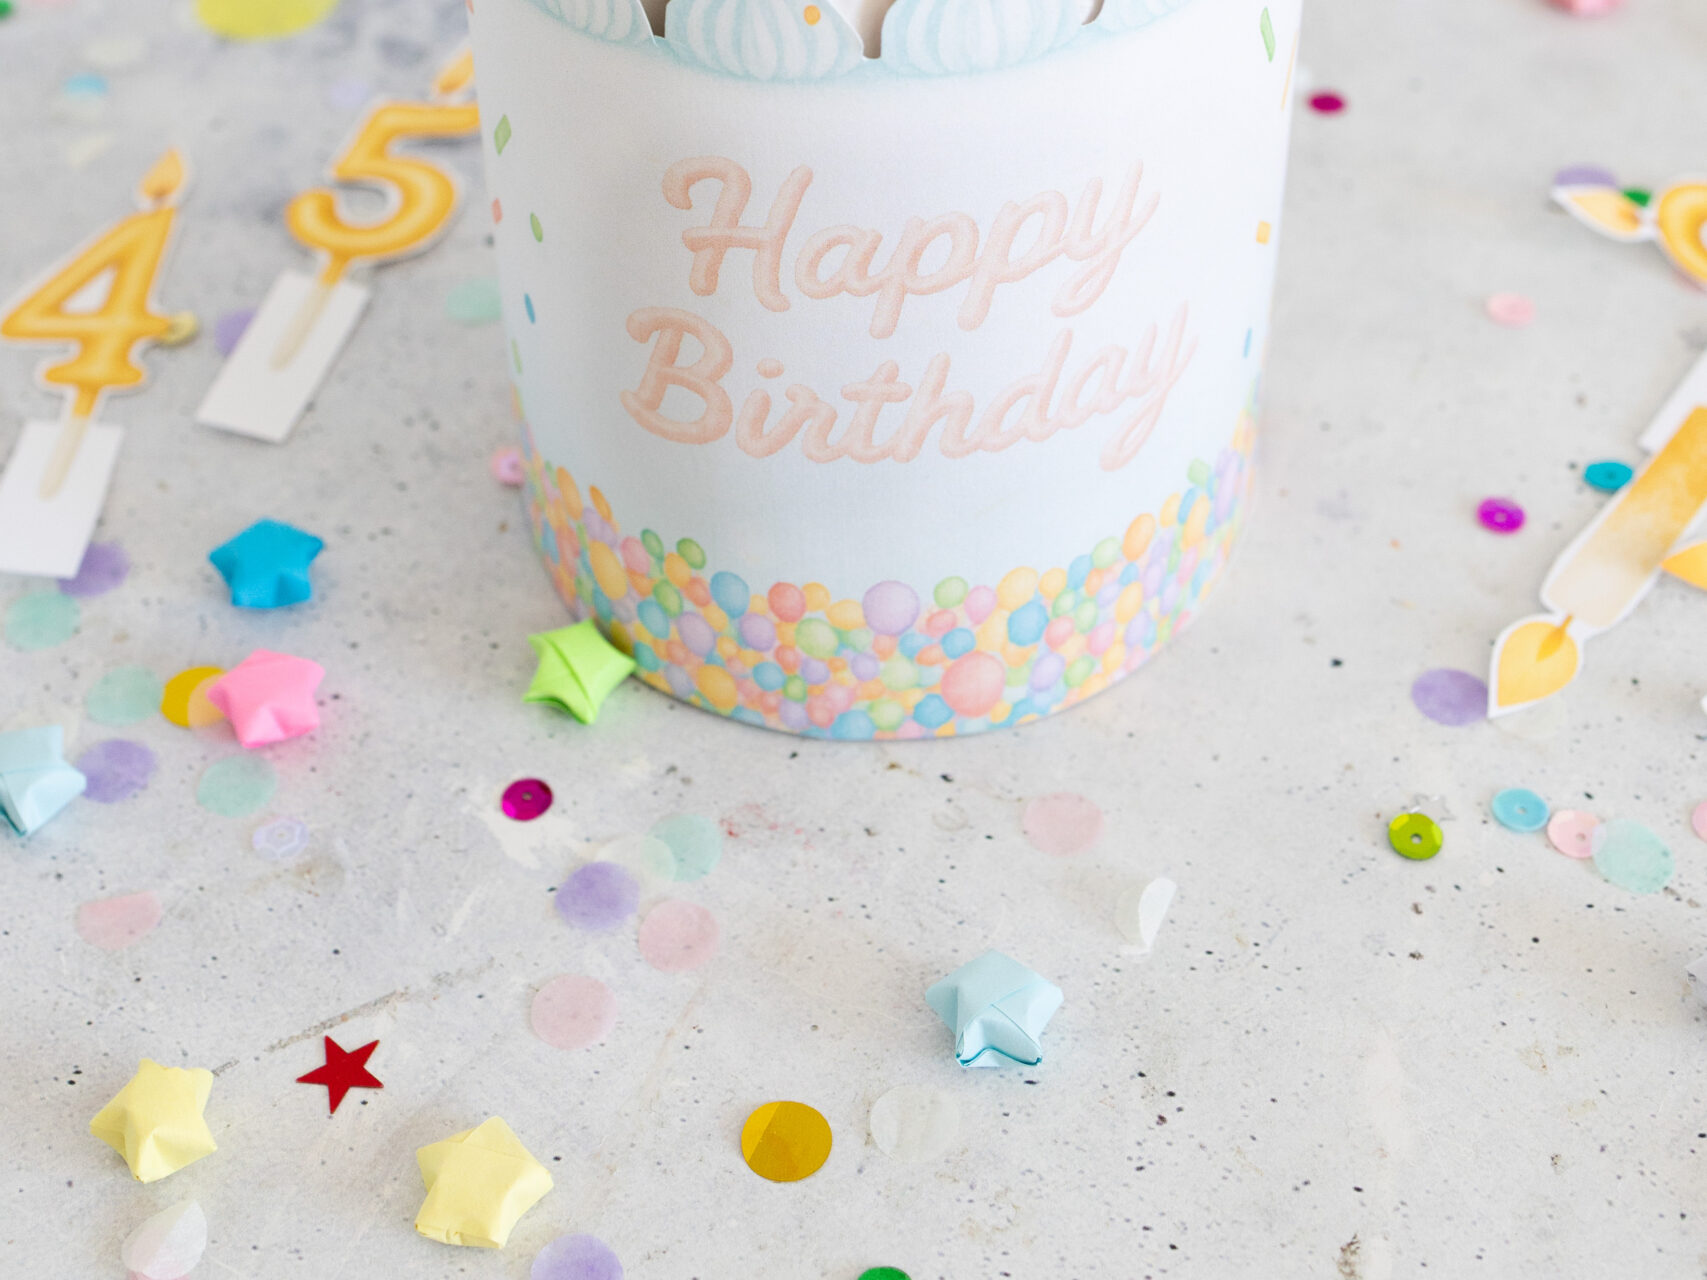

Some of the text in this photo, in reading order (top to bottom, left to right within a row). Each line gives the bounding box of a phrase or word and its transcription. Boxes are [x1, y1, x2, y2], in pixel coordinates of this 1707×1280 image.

[286, 100, 481, 261] 5
[661, 155, 1161, 339] Happy
[1, 207, 173, 388] 4
[619, 300, 1199, 472] Birthday
